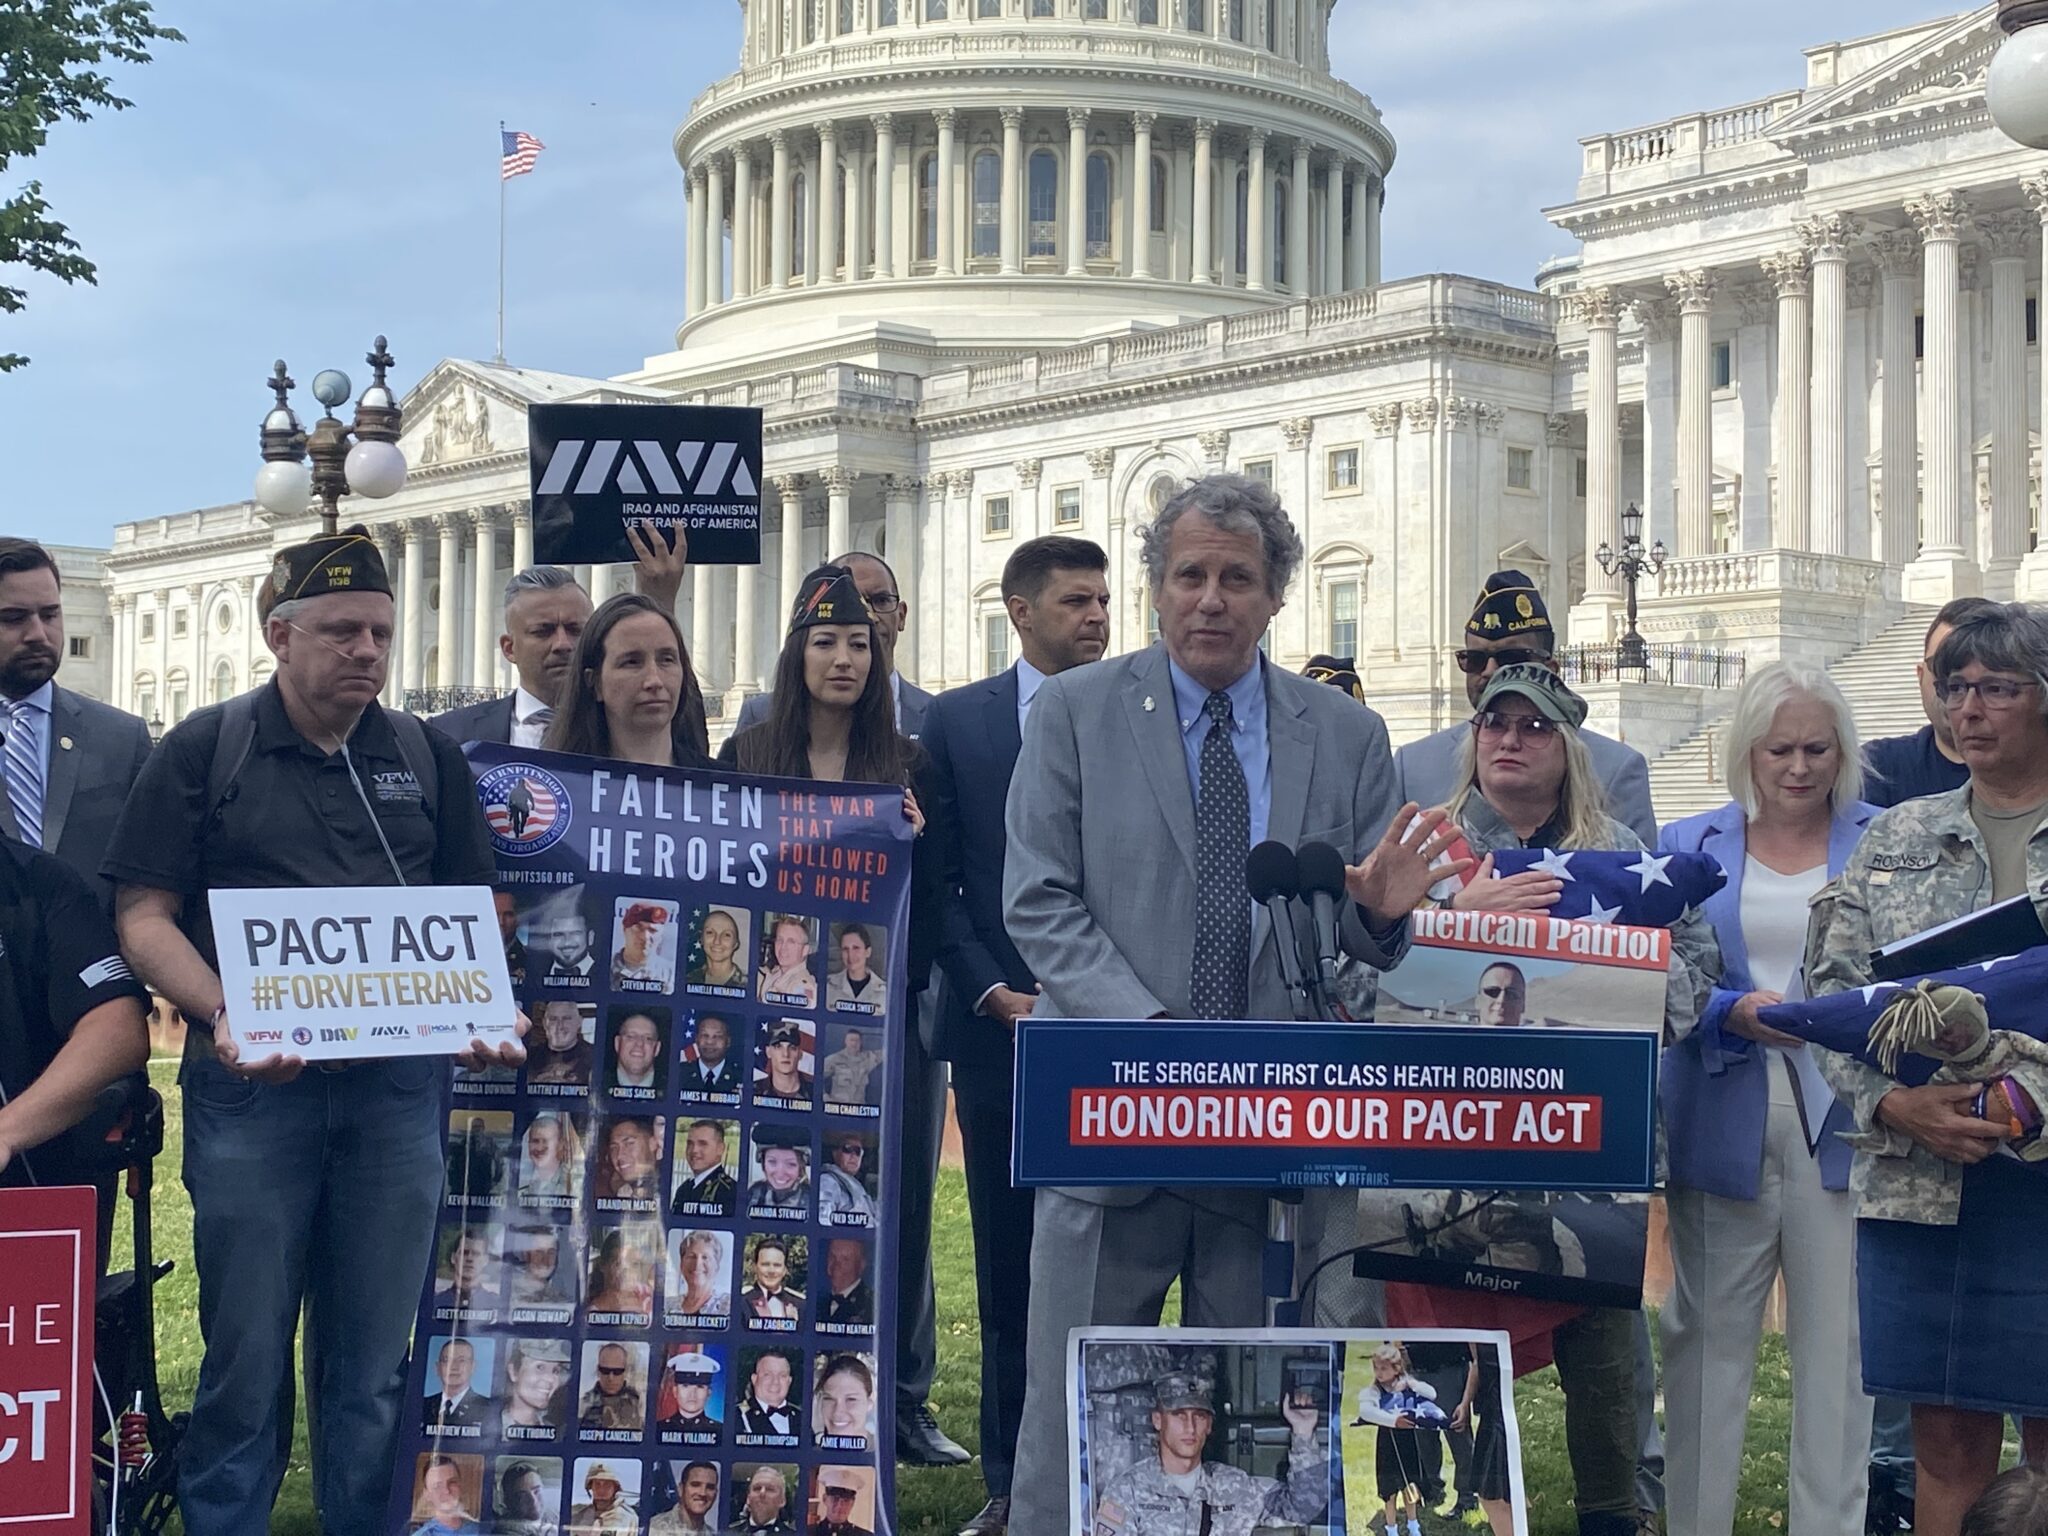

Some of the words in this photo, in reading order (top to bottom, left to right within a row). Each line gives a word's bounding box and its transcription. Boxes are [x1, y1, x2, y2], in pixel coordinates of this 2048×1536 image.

[536, 440, 758, 496] IAVA
[622, 503, 652, 515] IRAQ
[654, 503, 681, 515] AND
[682, 504, 758, 516] AFGHANISTAN
[622, 517, 688, 528] VETERANS
[690, 518, 707, 529] OF
[707, 518, 758, 530] AMERICA
[326, 566, 352, 577] VFW
[1508, 617, 1547, 631] CALIFORNIA
[371, 771, 418, 784] VFW
[480, 766, 563, 796] BURNPITS360
[591, 770, 762, 829] FALLEN
[778, 790, 817, 813] THE
[830, 795, 875, 817] WAR
[778, 816, 834, 840] THAT
[588, 827, 769, 888] HEROES
[778, 841, 888, 876] FOLLOWED
[1872, 853, 1932, 868] ROBNSON
[777, 870, 803, 894] US
[815, 875, 871, 903] HOME
[242, 915, 372, 967] PACT
[391, 914, 479, 963] ACT
[1412, 909, 1537, 949] merican
[1546, 917, 1663, 962] Patriot
[251, 969, 493, 1012] #FORVETERANS
[622, 980, 645, 991] STEVEN
[320, 1027, 359, 1042] DAV
[1111, 1061, 1150, 1083] THE
[1155, 1061, 1259, 1085] SERGEANT
[1263, 1063, 1319, 1085] FIRST
[1324, 1063, 1388, 1087] CLASS
[1394, 1065, 1456, 1088] HEATH
[1463, 1066, 1565, 1090] ROBINSON
[452, 1083, 483, 1094] AMANDA
[527, 1085, 559, 1095] MATTHEW
[613, 1087, 633, 1098] CHRIS
[634, 1088, 656, 1099] SACHS
[680, 1090, 701, 1101] JAMES
[1080, 1095, 1293, 1139] HONORING
[1306, 1097, 1389, 1140] OUR
[1402, 1099, 1503, 1142] PACT
[1512, 1101, 1591, 1144] ACT
[1348, 1172, 1390, 1186] AFFAIRS
[597, 1199, 632, 1210] BRANDON
[683, 1202, 699, 1214] JEFF
[699, 1203, 723, 1215] WELLS
[749, 1206, 777, 1218] AMANDA
[778, 1207, 807, 1220] STEWART
[1464, 1271, 1521, 1291] Major
[665, 1316, 697, 1327] DEBORAH
[697, 1316, 727, 1328] BECKETT
[526, 1427, 556, 1439] THOMAS
[578, 1429, 604, 1440] JOSEPH
[661, 1431, 683, 1443] MARK
[736, 1434, 763, 1445] WILLIAM
[839, 1437, 866, 1449] MULLER
